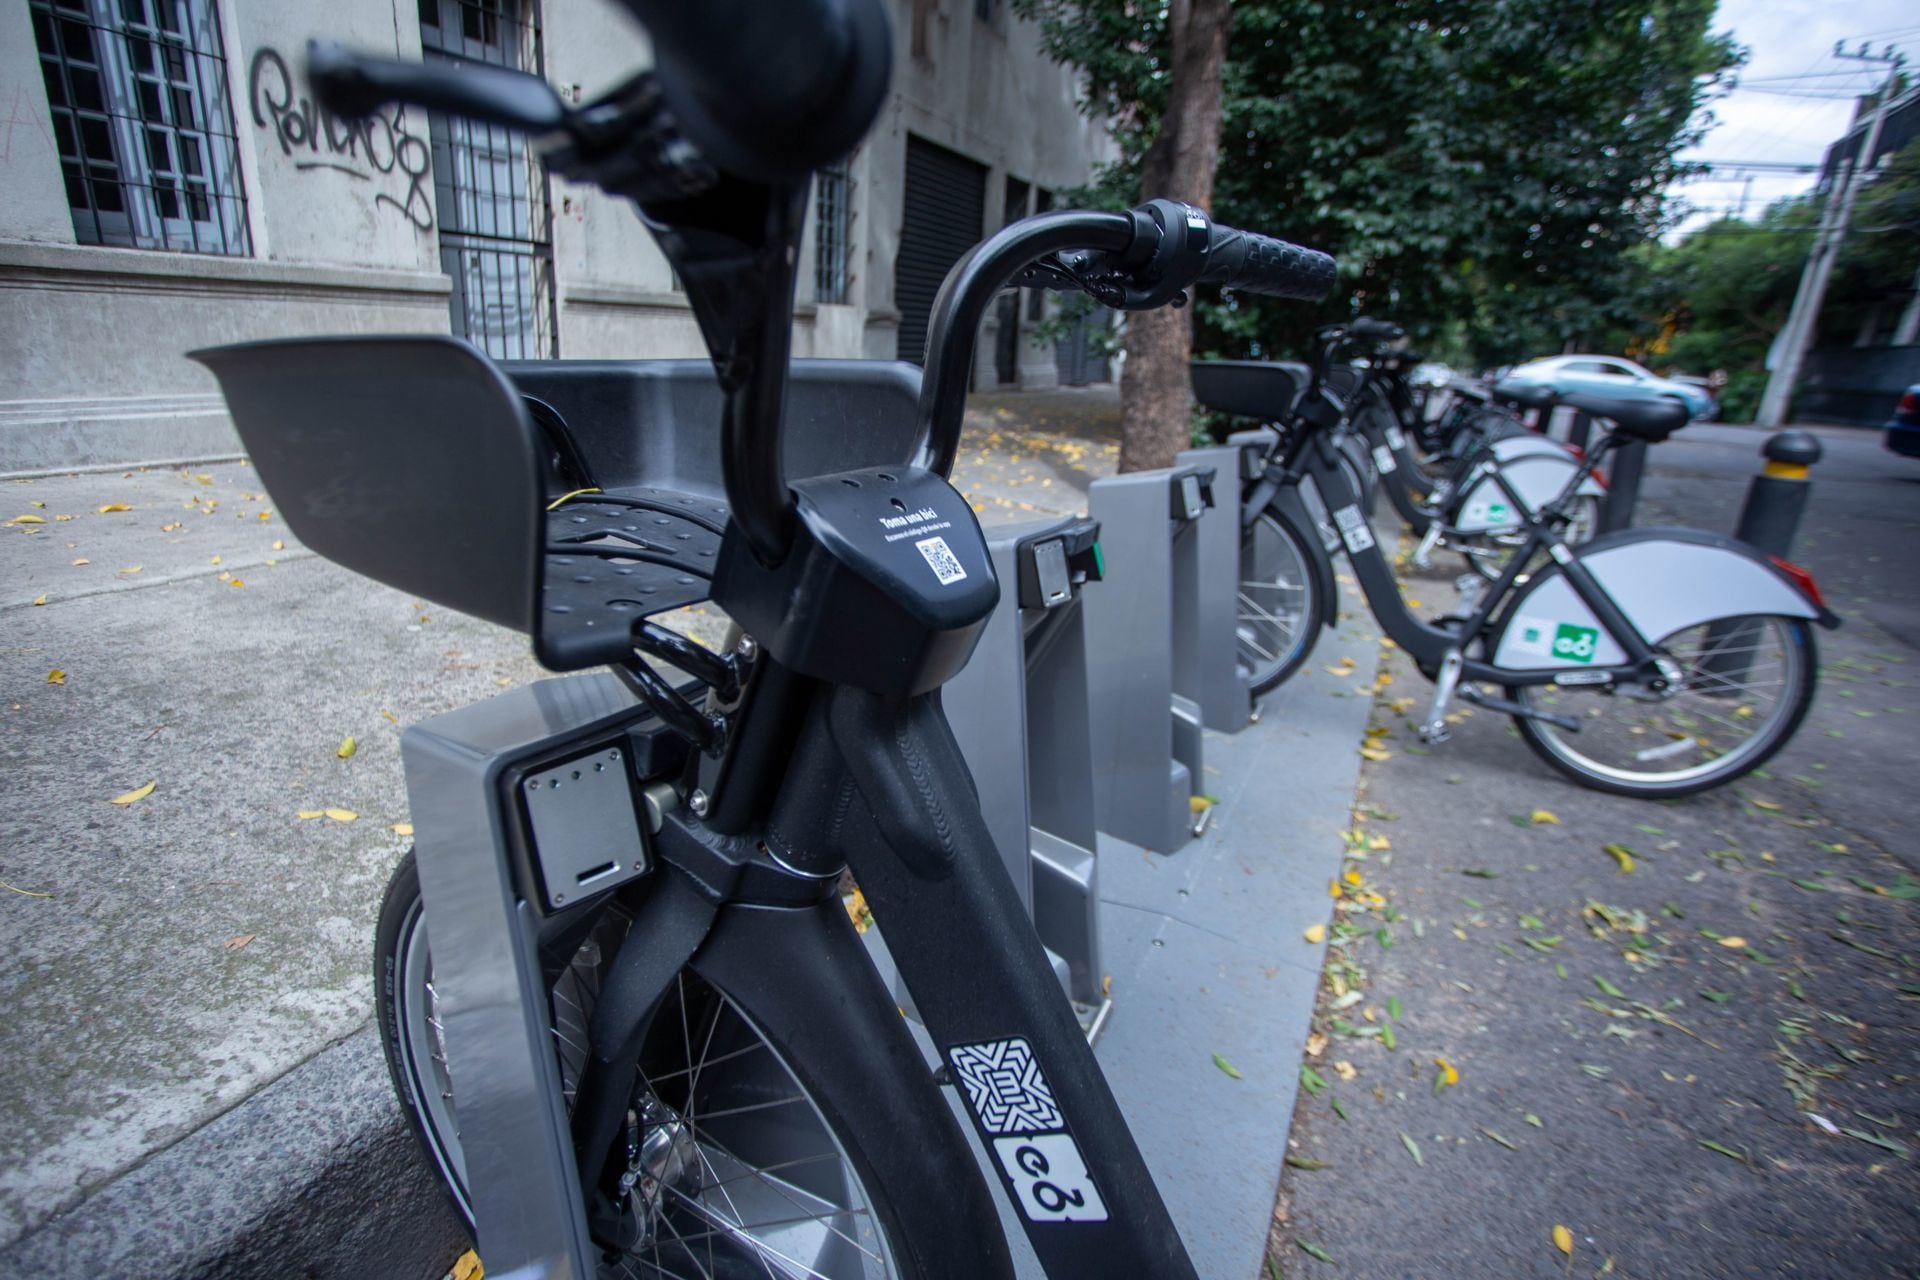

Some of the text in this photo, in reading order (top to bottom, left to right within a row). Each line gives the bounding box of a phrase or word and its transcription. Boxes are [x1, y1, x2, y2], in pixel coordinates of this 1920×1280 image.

[879, 507, 938, 529] Toma una bici
